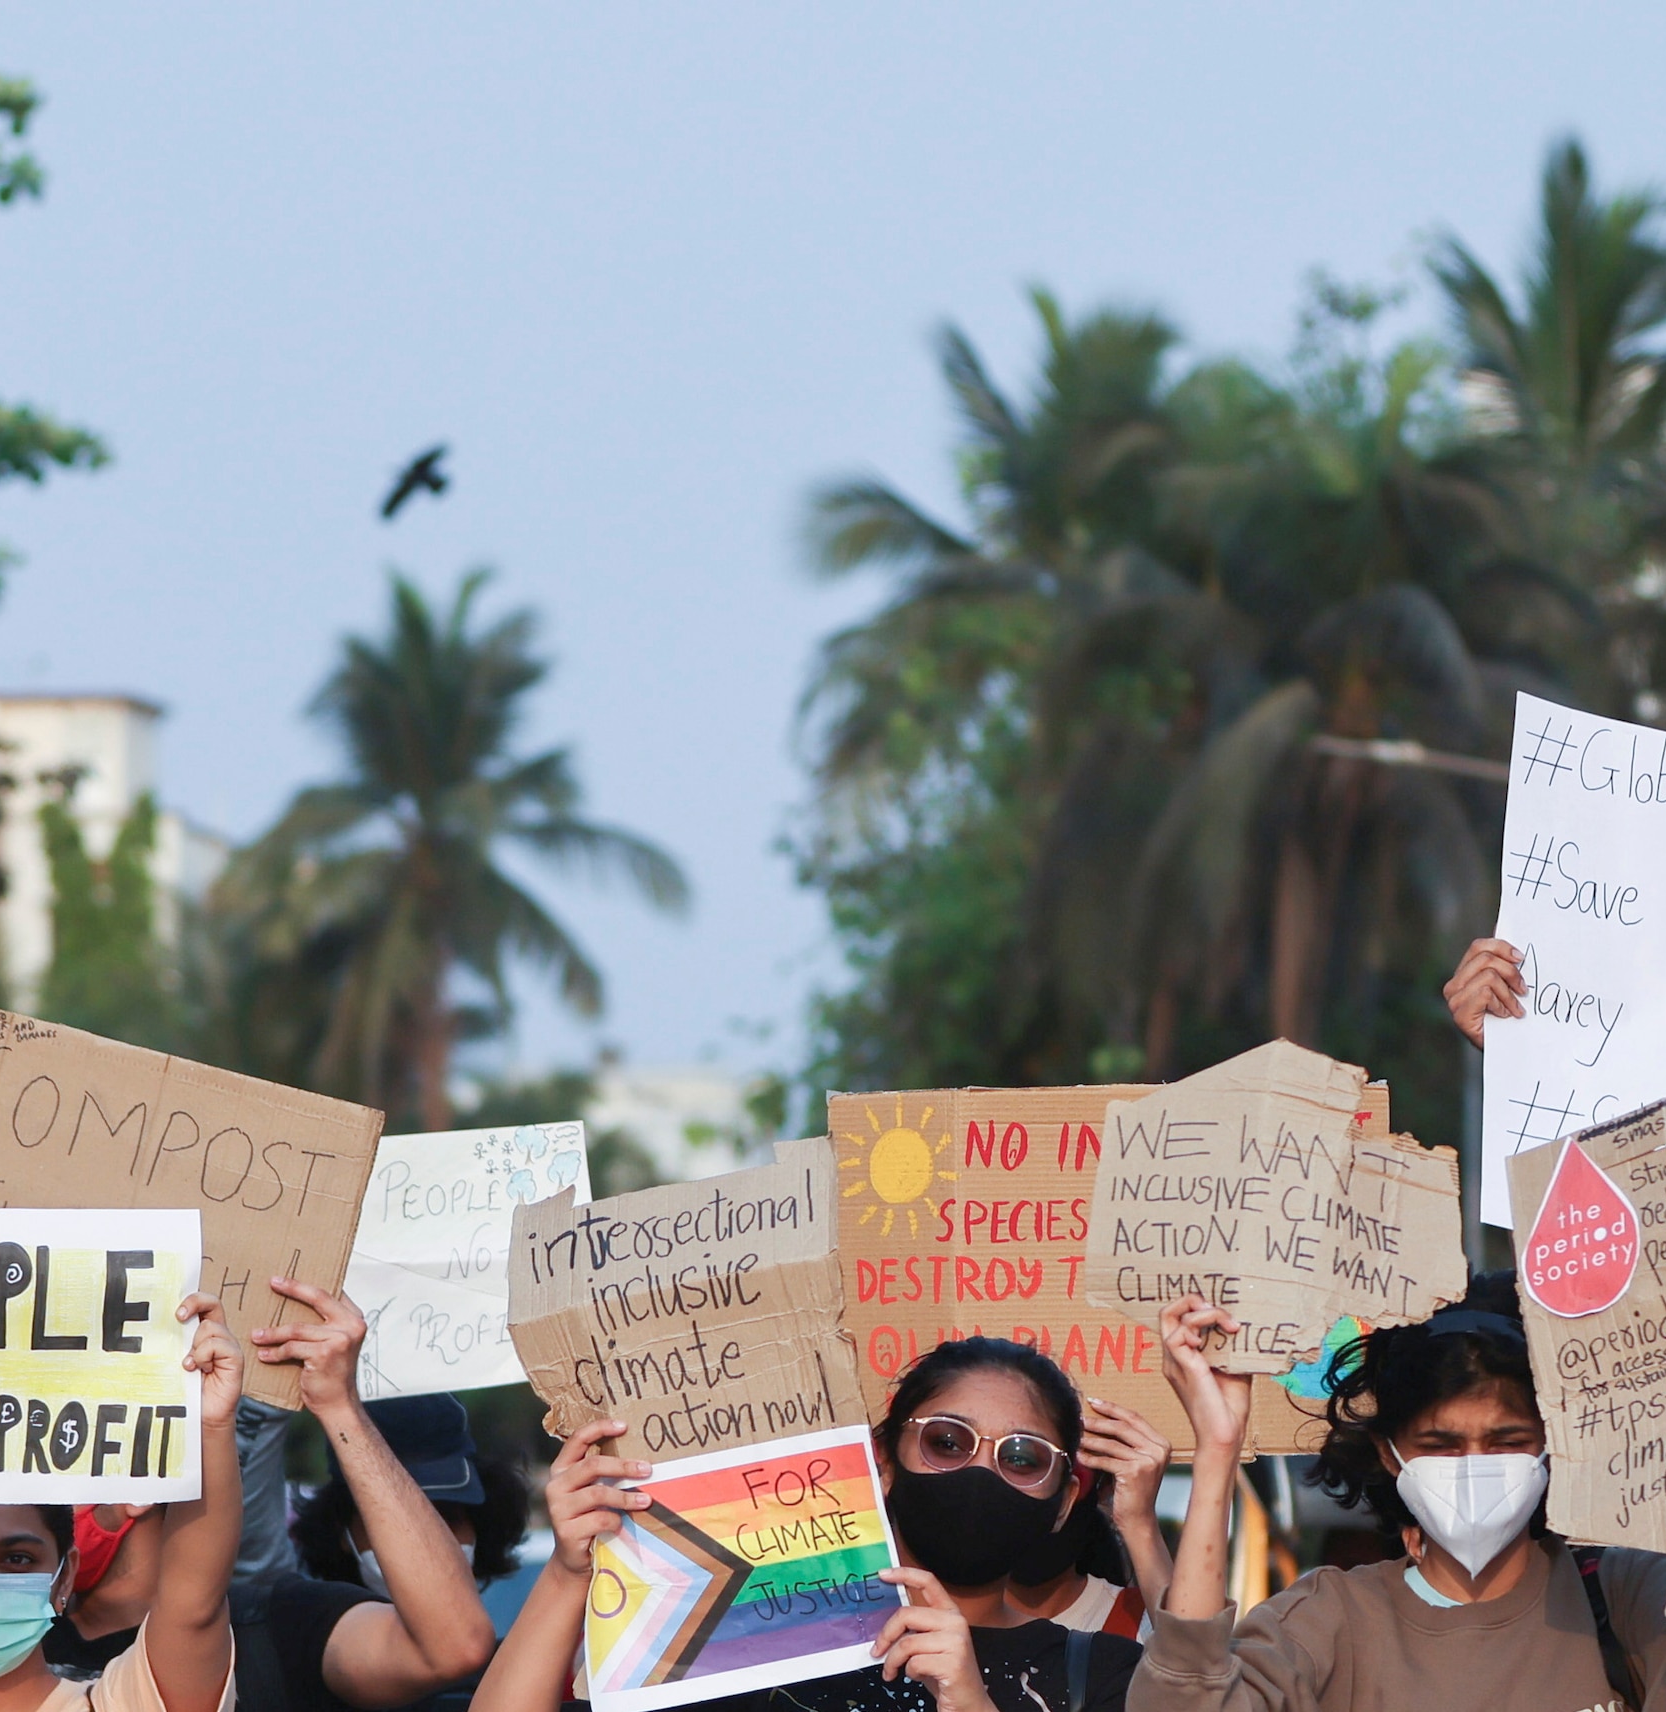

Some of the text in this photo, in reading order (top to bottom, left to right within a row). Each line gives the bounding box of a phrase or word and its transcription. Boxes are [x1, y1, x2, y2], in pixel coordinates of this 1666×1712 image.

[1507, 832, 1645, 927] #Save
[965, 1119, 1029, 1172] NO
[1116, 1108, 1412, 1214] WE WANT
[377, 1160, 502, 1223] PEOPLE
[1110, 1173, 1403, 1256] INCLUSIVE CLIMATE
[1557, 1203, 1602, 1230] the
[527, 1168, 815, 1285] intersectional
[934, 1198, 1089, 1246] SPECIES
[1535, 1212, 1627, 1267] period
[856, 1255, 1044, 1306] DESTROY
[1113, 1214, 1417, 1318] ACTION. WE WANT
[1116, 1265, 1242, 1305] CLIMATE
[1532, 1241, 1634, 1287] society
[588, 1252, 761, 1336] inclusive
[409, 1302, 513, 1366] PROFI
[574, 1320, 746, 1407] climate
[1579, 1376, 1610, 1405] for
[642, 1392, 756, 1453] action
[741, 1458, 842, 1510] FOR
[735, 1510, 861, 1561] CLIMATE
[748, 1570, 886, 1622] JUSTICE
